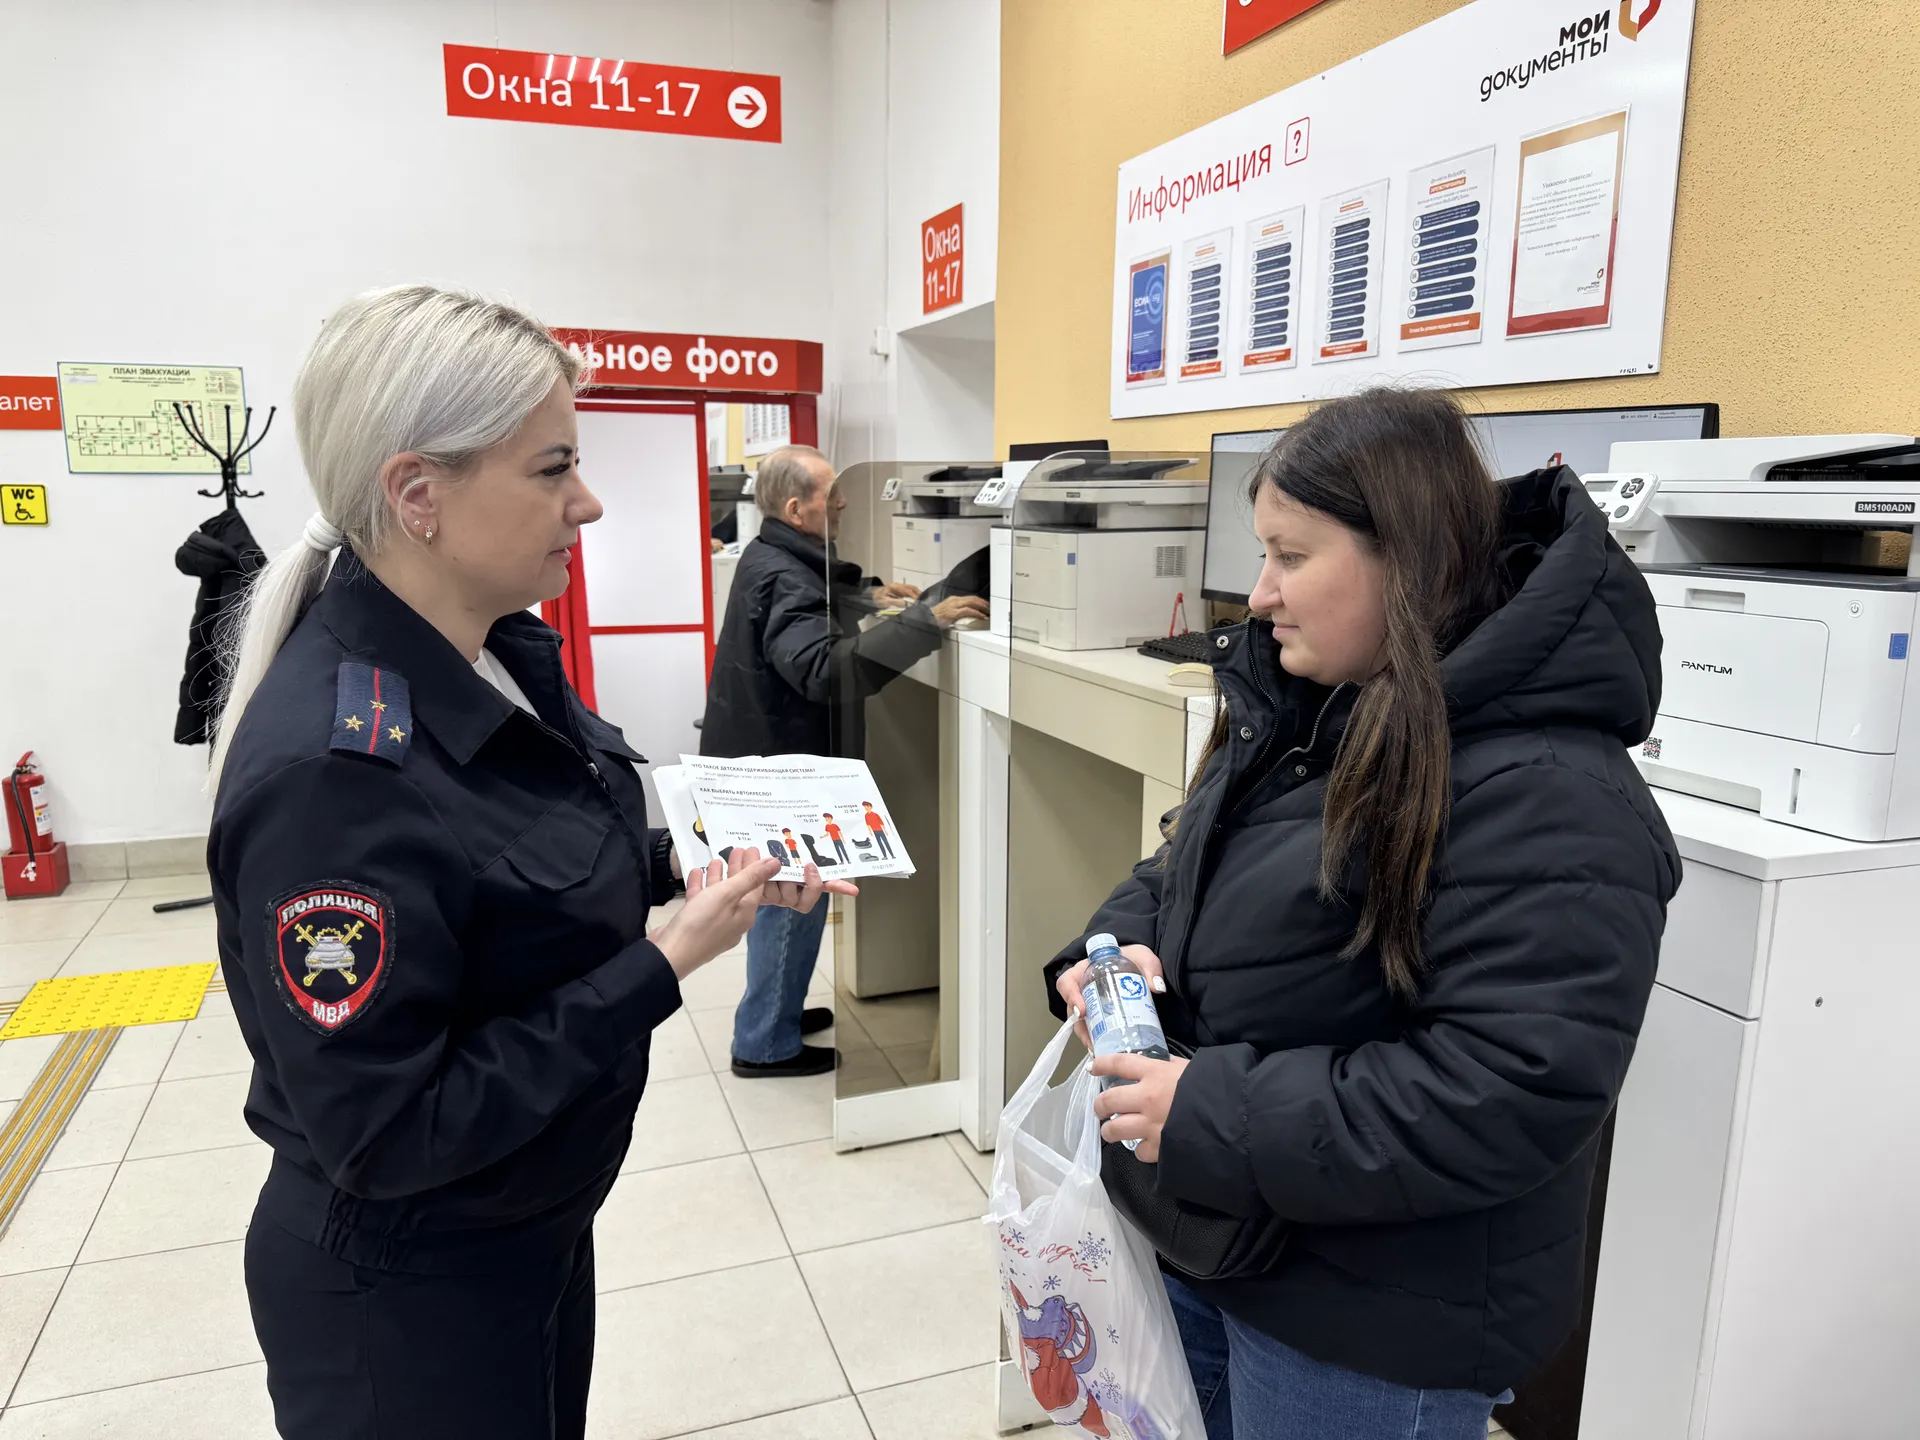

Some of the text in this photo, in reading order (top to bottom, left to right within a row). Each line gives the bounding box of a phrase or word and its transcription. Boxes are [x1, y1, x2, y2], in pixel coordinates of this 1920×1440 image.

[1480, 33, 1608, 102] документы
[462, 63, 700, 117] Окна 11-17
[1128, 144, 1271, 224] Информация
[925, 223, 960, 263] Окна
[926, 260, 960, 305] 11-17
[113, 367, 190, 376] ПЛАН ЭВАКУАЦИИ
[686, 337, 778, 382] фото
[12, 489, 35, 500] WC
[1858, 503, 1911, 512] BM5100ADN
[1681, 660, 1732, 675] PANTUM
[282, 894, 378, 924] ПОЛИЦИЯ
[313, 1001, 349, 1024] МВД
